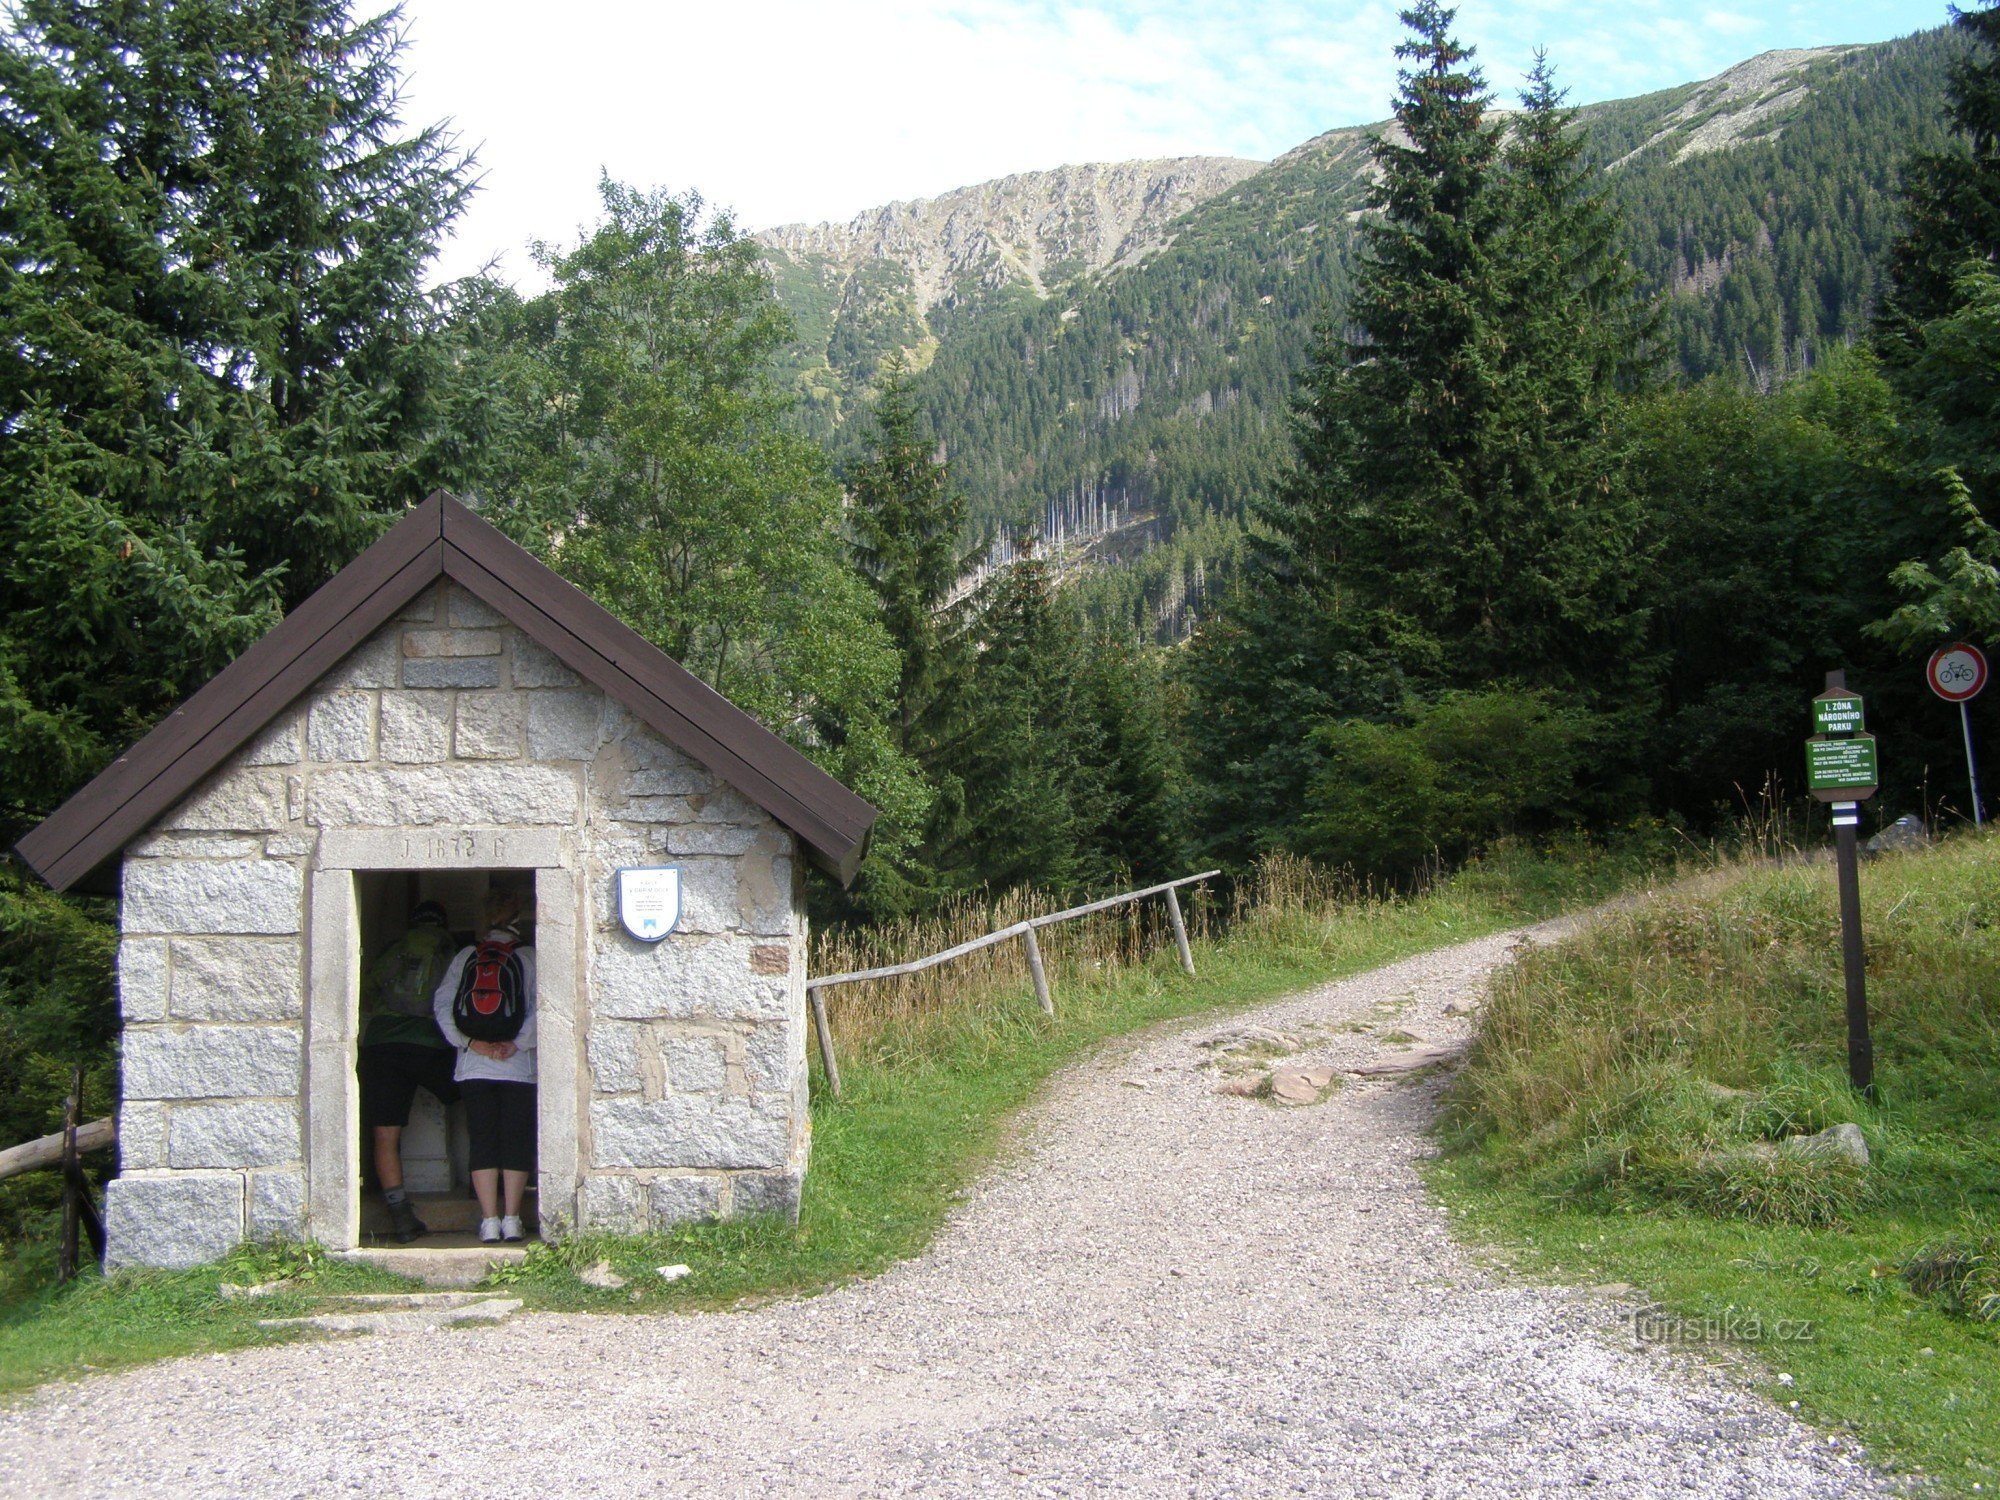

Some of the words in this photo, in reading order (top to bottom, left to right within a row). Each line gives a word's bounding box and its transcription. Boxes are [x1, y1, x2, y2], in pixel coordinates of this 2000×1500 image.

[1825, 703, 1831, 711] I.
[1832, 701, 1852, 711] ZÓNA
[1818, 711, 1860, 721] NÁRODNÍHO
[1828, 722, 1852, 731] PARKU
